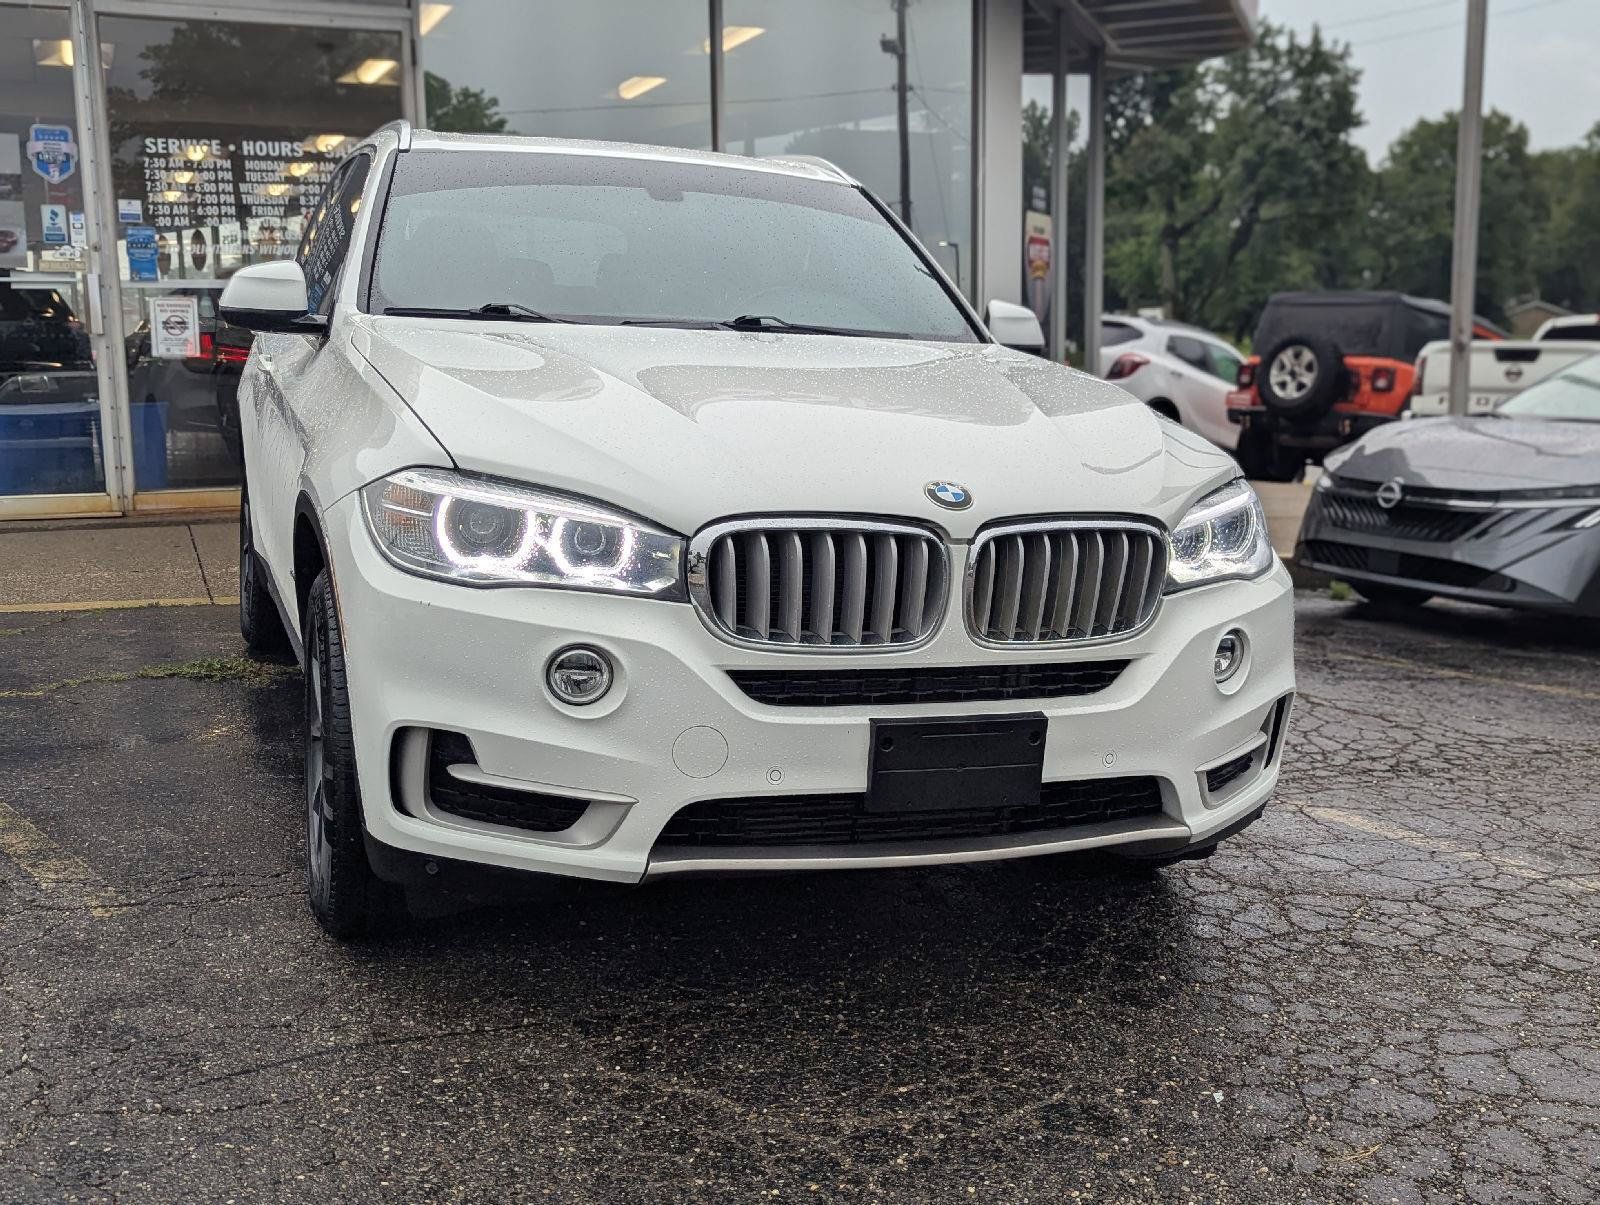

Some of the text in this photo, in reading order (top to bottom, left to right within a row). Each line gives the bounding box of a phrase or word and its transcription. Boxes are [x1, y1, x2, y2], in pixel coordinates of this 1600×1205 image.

[241, 140, 304, 157] HOURS
[143, 157, 166, 168] 7:30
[168, 158, 185, 168] AM
[216, 159, 232, 169] PM
[244, 160, 285, 171] MONDAY
[144, 169, 167, 180] 7:30
[217, 171, 233, 181] PM
[244, 172, 285, 182] TUESDAY
[145, 181, 168, 191] 7:30
[194, 182, 217, 192] 6:00
[218, 182, 234, 192] PM
[197, 194, 218, 204] 7:00
[220, 194, 235, 204] PM
[242, 195, 290, 205] THURSDAY
[148, 204, 171, 215] 7:30
[172, 205, 189, 215] AM
[197, 205, 219, 215] 6:00
[221, 205, 236, 216] PM
[252, 205, 285, 216] FRIDAY
[173, 216, 190, 226] AM
